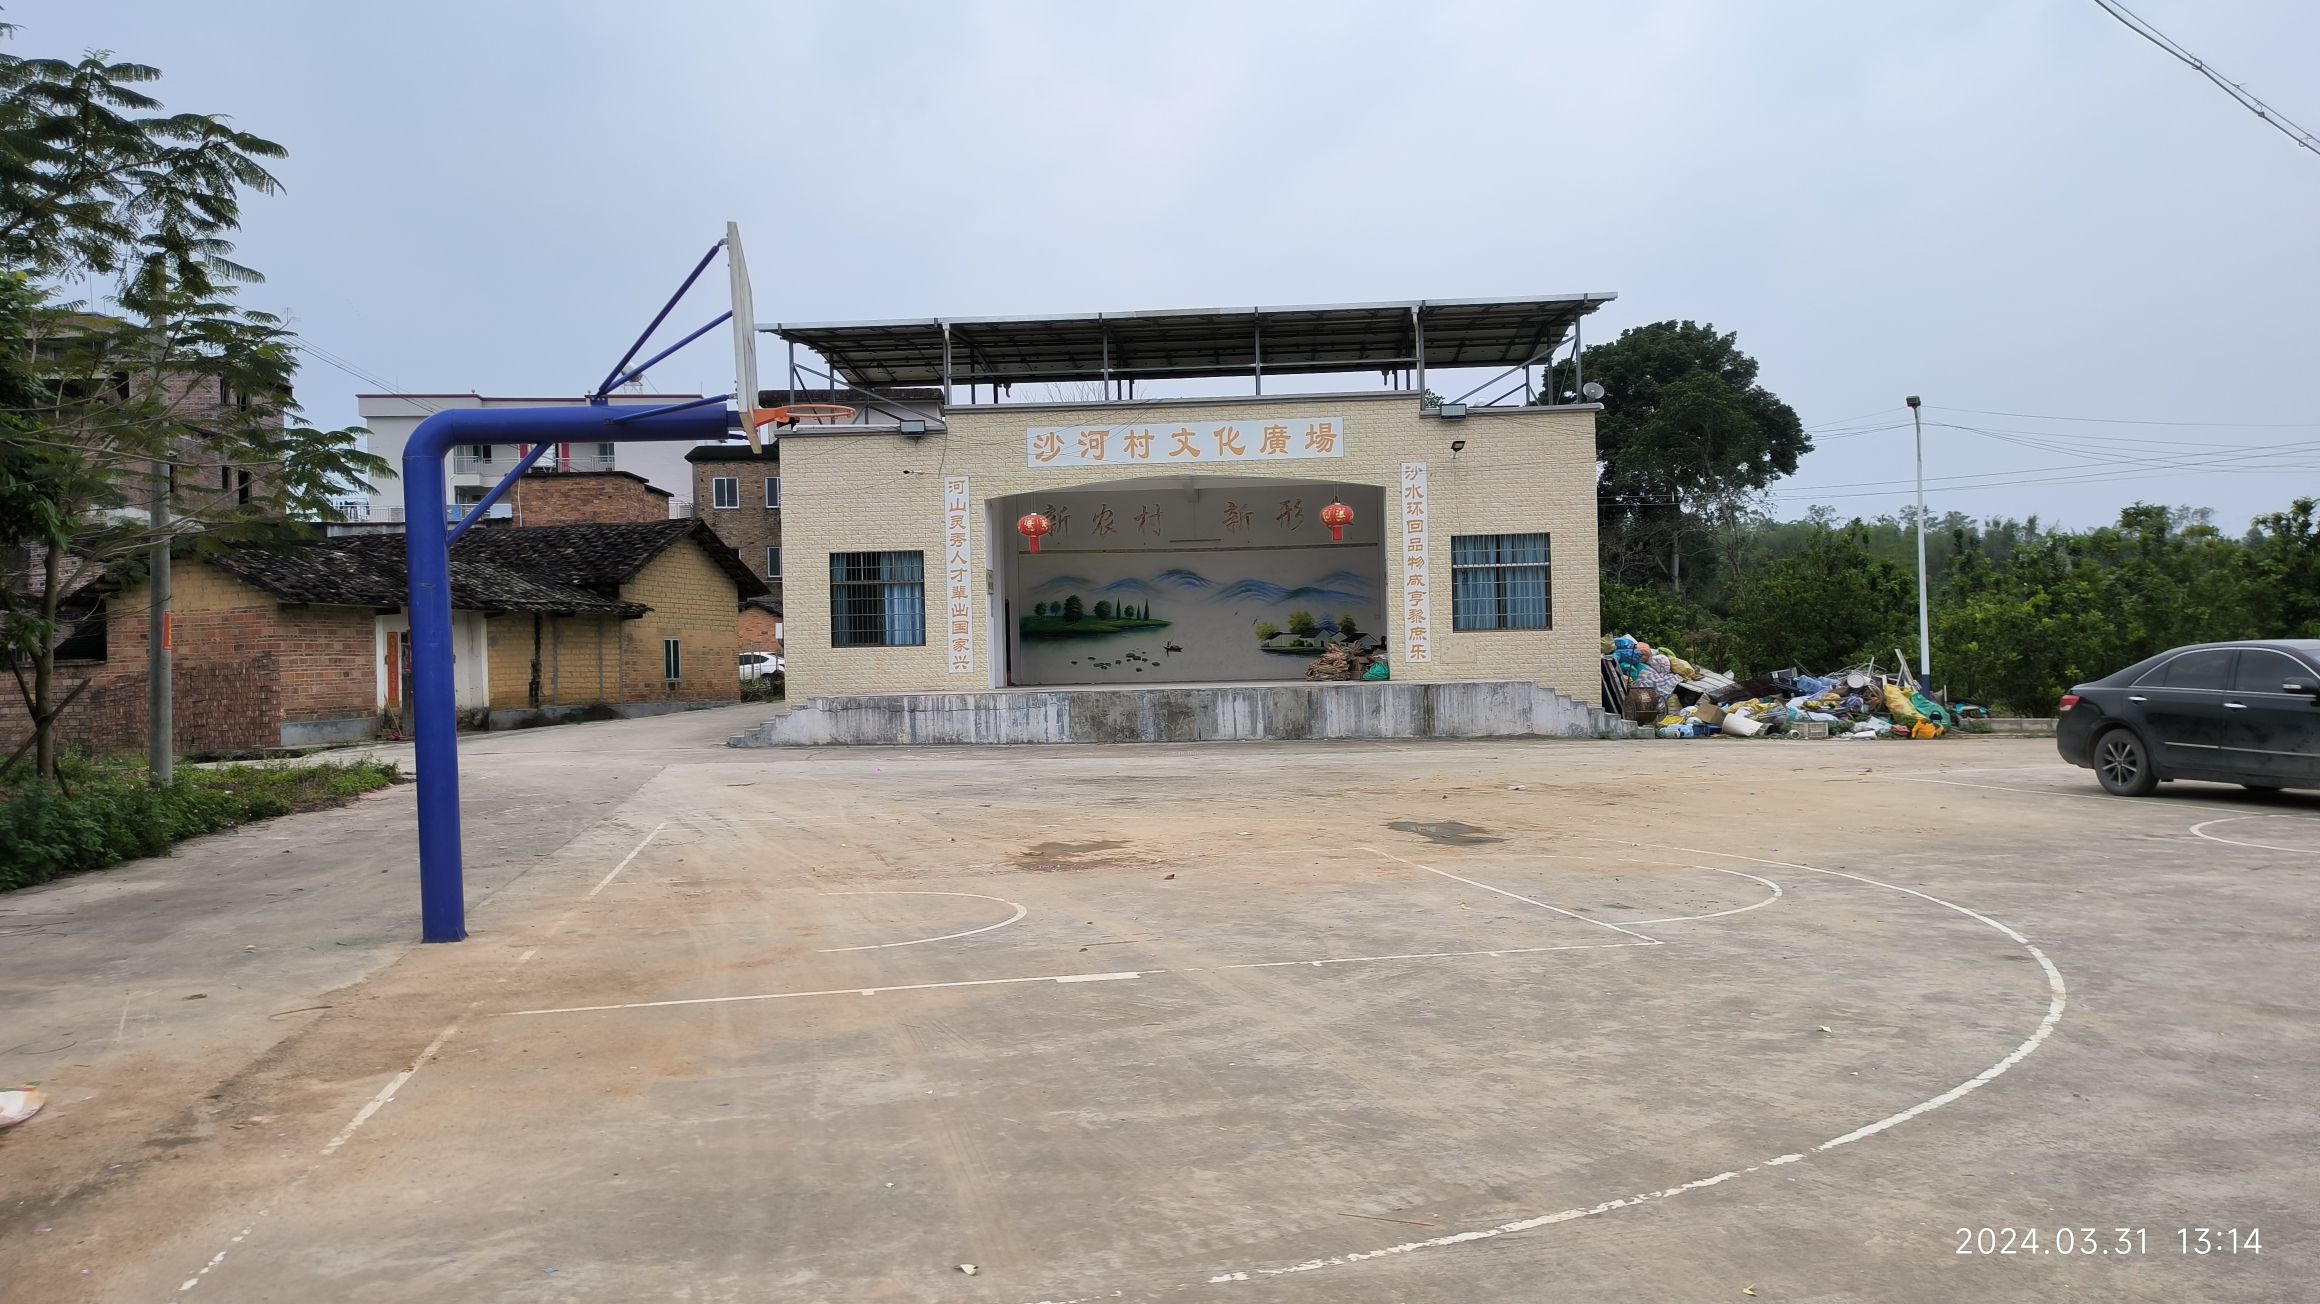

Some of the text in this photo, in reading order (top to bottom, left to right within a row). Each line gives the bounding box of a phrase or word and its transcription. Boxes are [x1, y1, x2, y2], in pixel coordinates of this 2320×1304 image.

[1032, 423, 1338, 463] 沙河村文化廣場
